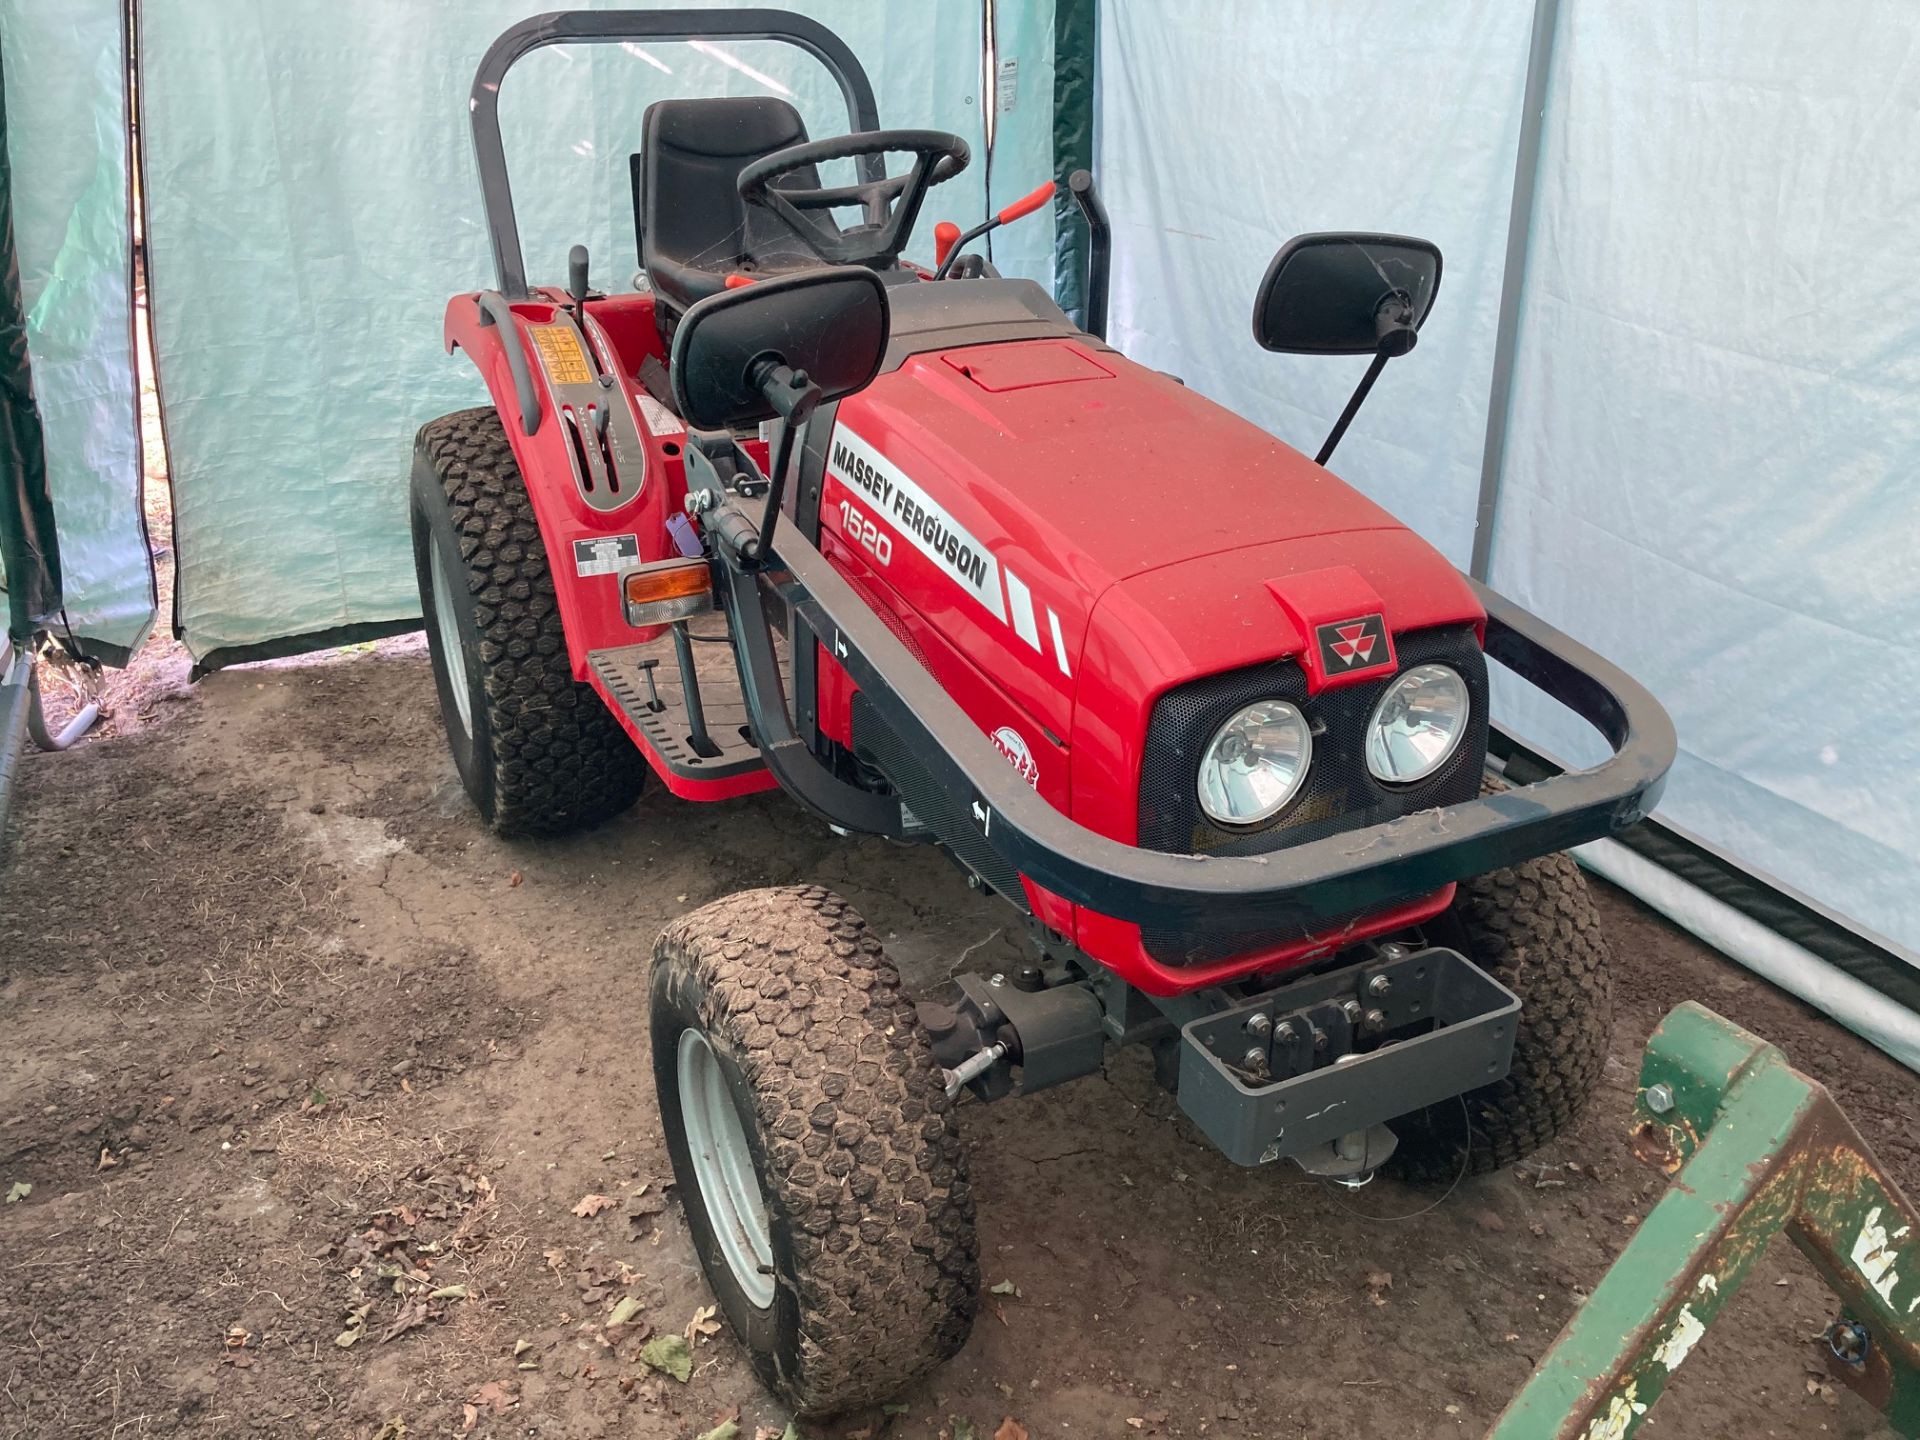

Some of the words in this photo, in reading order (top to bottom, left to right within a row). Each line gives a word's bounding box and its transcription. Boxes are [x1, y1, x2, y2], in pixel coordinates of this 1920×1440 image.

[834, 442, 893, 505] MASSEY
[894, 490, 987, 589] FERGUSON
[840, 501, 892, 567] 1520
